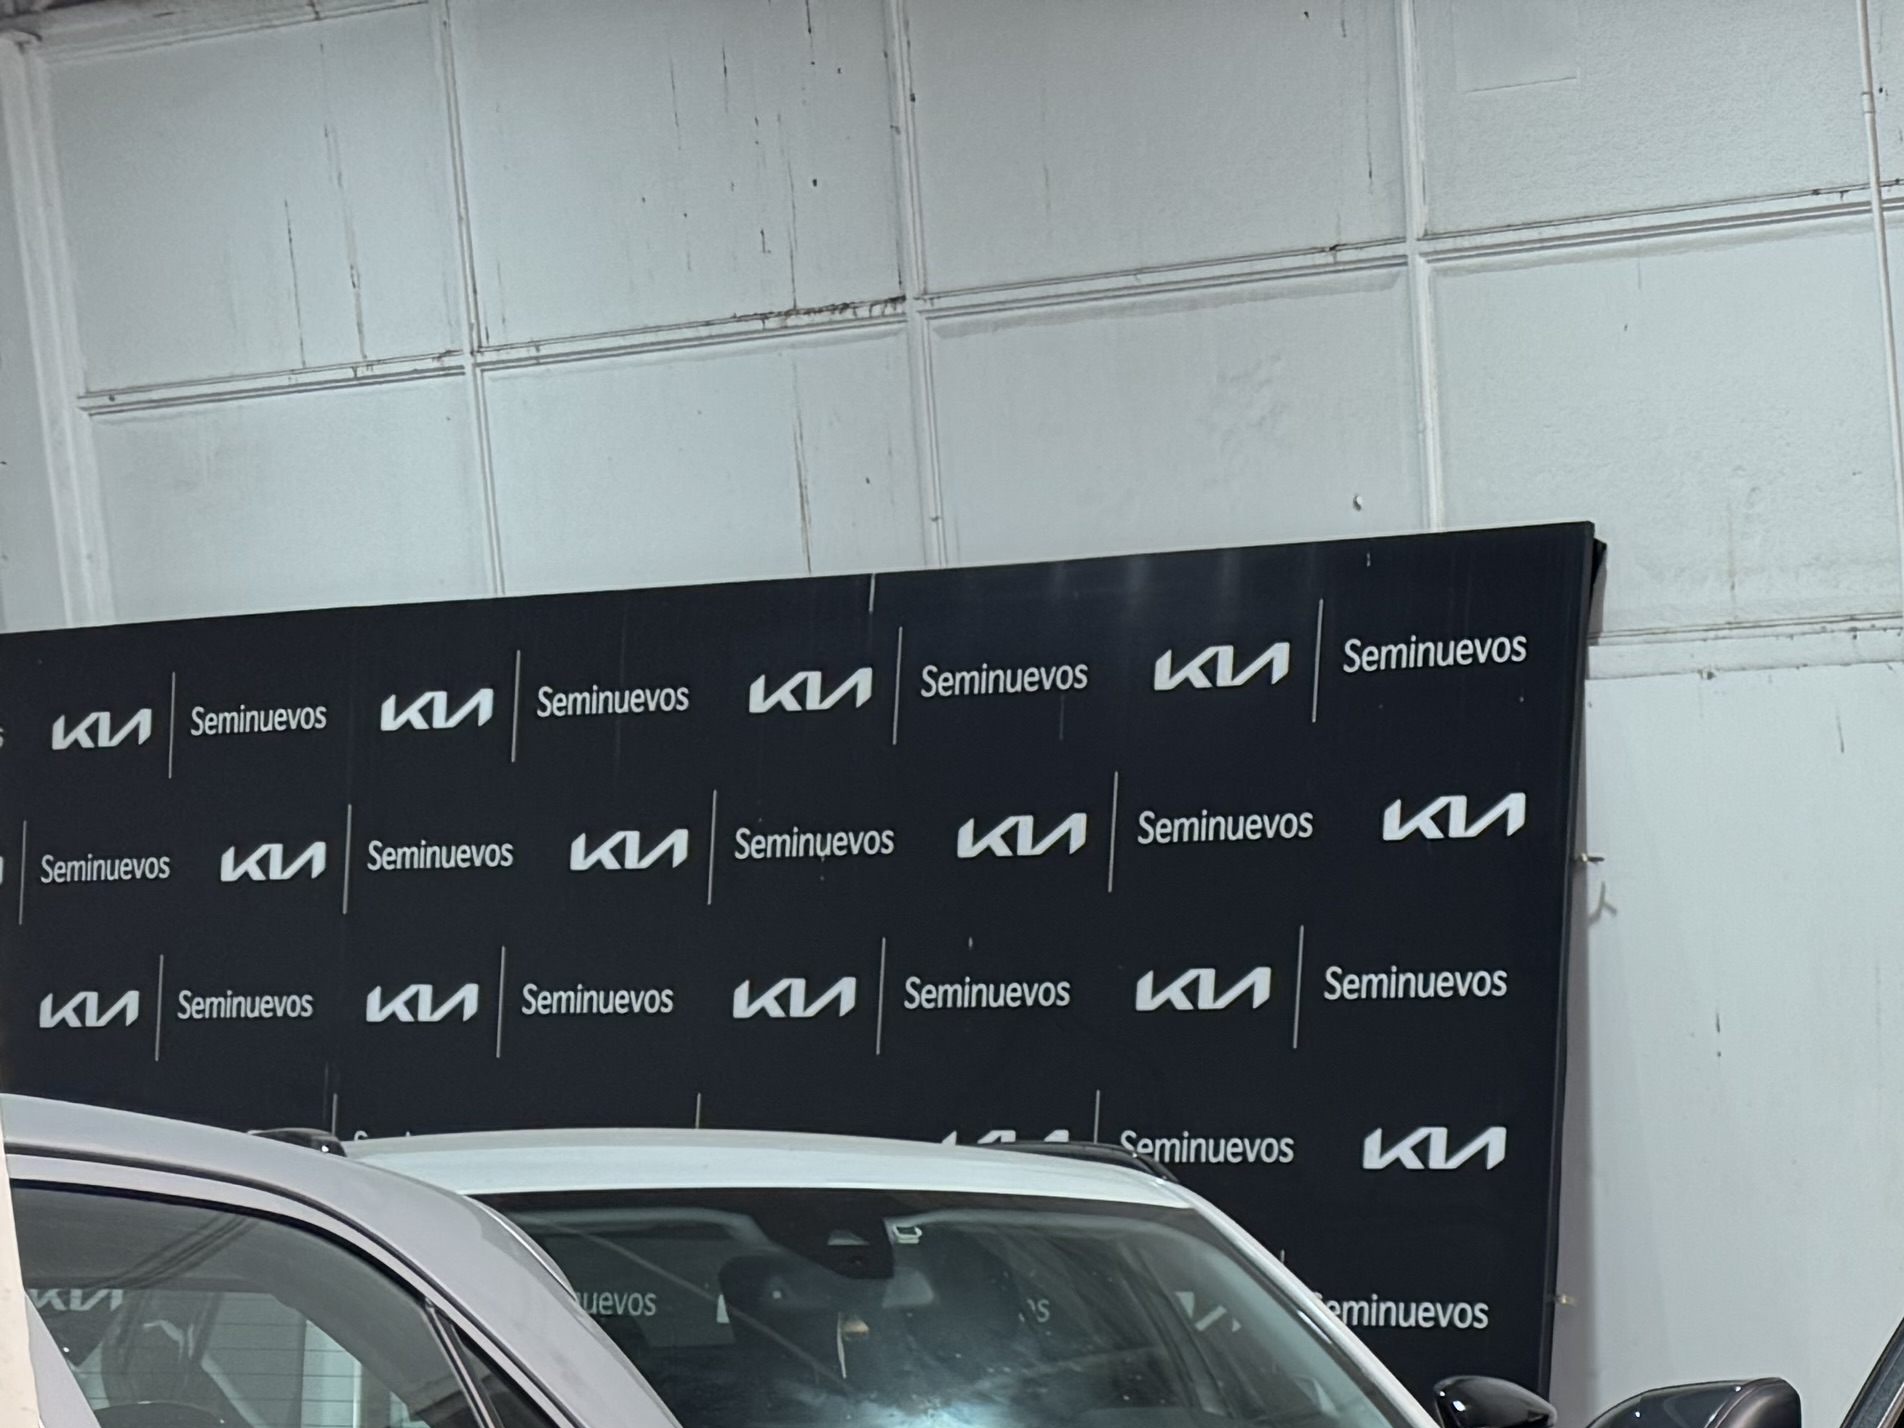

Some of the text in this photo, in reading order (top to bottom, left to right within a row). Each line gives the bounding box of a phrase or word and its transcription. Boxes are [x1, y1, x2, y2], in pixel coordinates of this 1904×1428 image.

[1343, 634, 1527, 673] Seminuevos
[920, 662, 1088, 698] Seminuevos
[536, 684, 689, 718] Seminuevos
[190, 704, 327, 736] Seminuevos
[734, 826, 895, 860] Seminuevos
[1137, 809, 1314, 845] Seminuevos
[40, 853, 171, 884] Seminuevos
[367, 839, 514, 871] Seminuevos
[521, 983, 674, 1015] Seminuevos
[903, 976, 1071, 1010] Seminuevos
[1323, 965, 1508, 1001] Seminuevos
[177, 989, 314, 1020] Seminuevos
[577, 1291, 658, 1317] uevos
[1312, 1291, 1489, 1329] eminuevos
